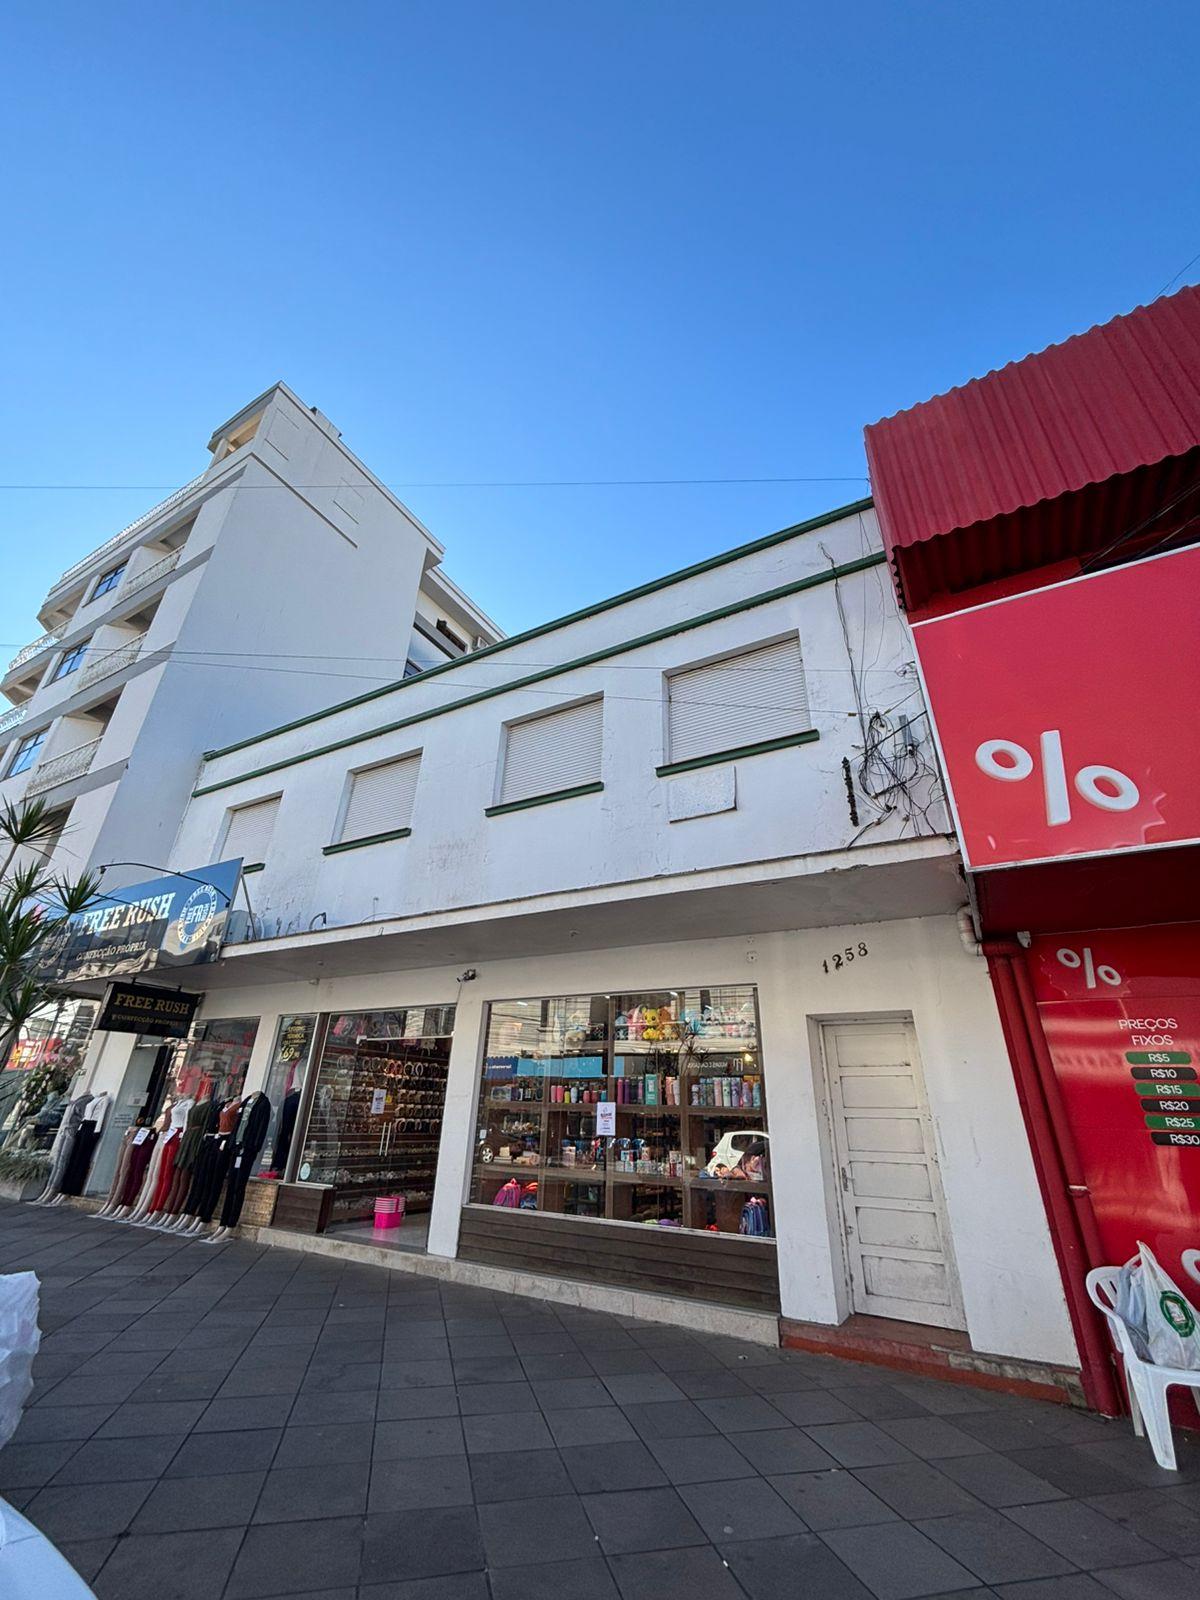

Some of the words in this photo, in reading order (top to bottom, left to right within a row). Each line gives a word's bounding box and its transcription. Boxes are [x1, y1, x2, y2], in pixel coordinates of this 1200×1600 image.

[77, 905, 126, 936] FREE
[122, 892, 176, 927] RUSH
[822, 942, 868, 974] 1258
[114, 993, 154, 1010] FREE
[153, 999, 190, 1015] RUSH
[1118, 1018, 1178, 1032] PREÇOS
[1131, 1034, 1174, 1046] FIXOS
[1148, 1053, 1170, 1063] R$5
[1150, 1068, 1177, 1079] R$10
[1155, 1084, 1183, 1095] R$15
[1159, 1100, 1190, 1111] R$20
[1164, 1117, 1196, 1128] R$25
[1169, 1134, 1200, 1145] R$30
